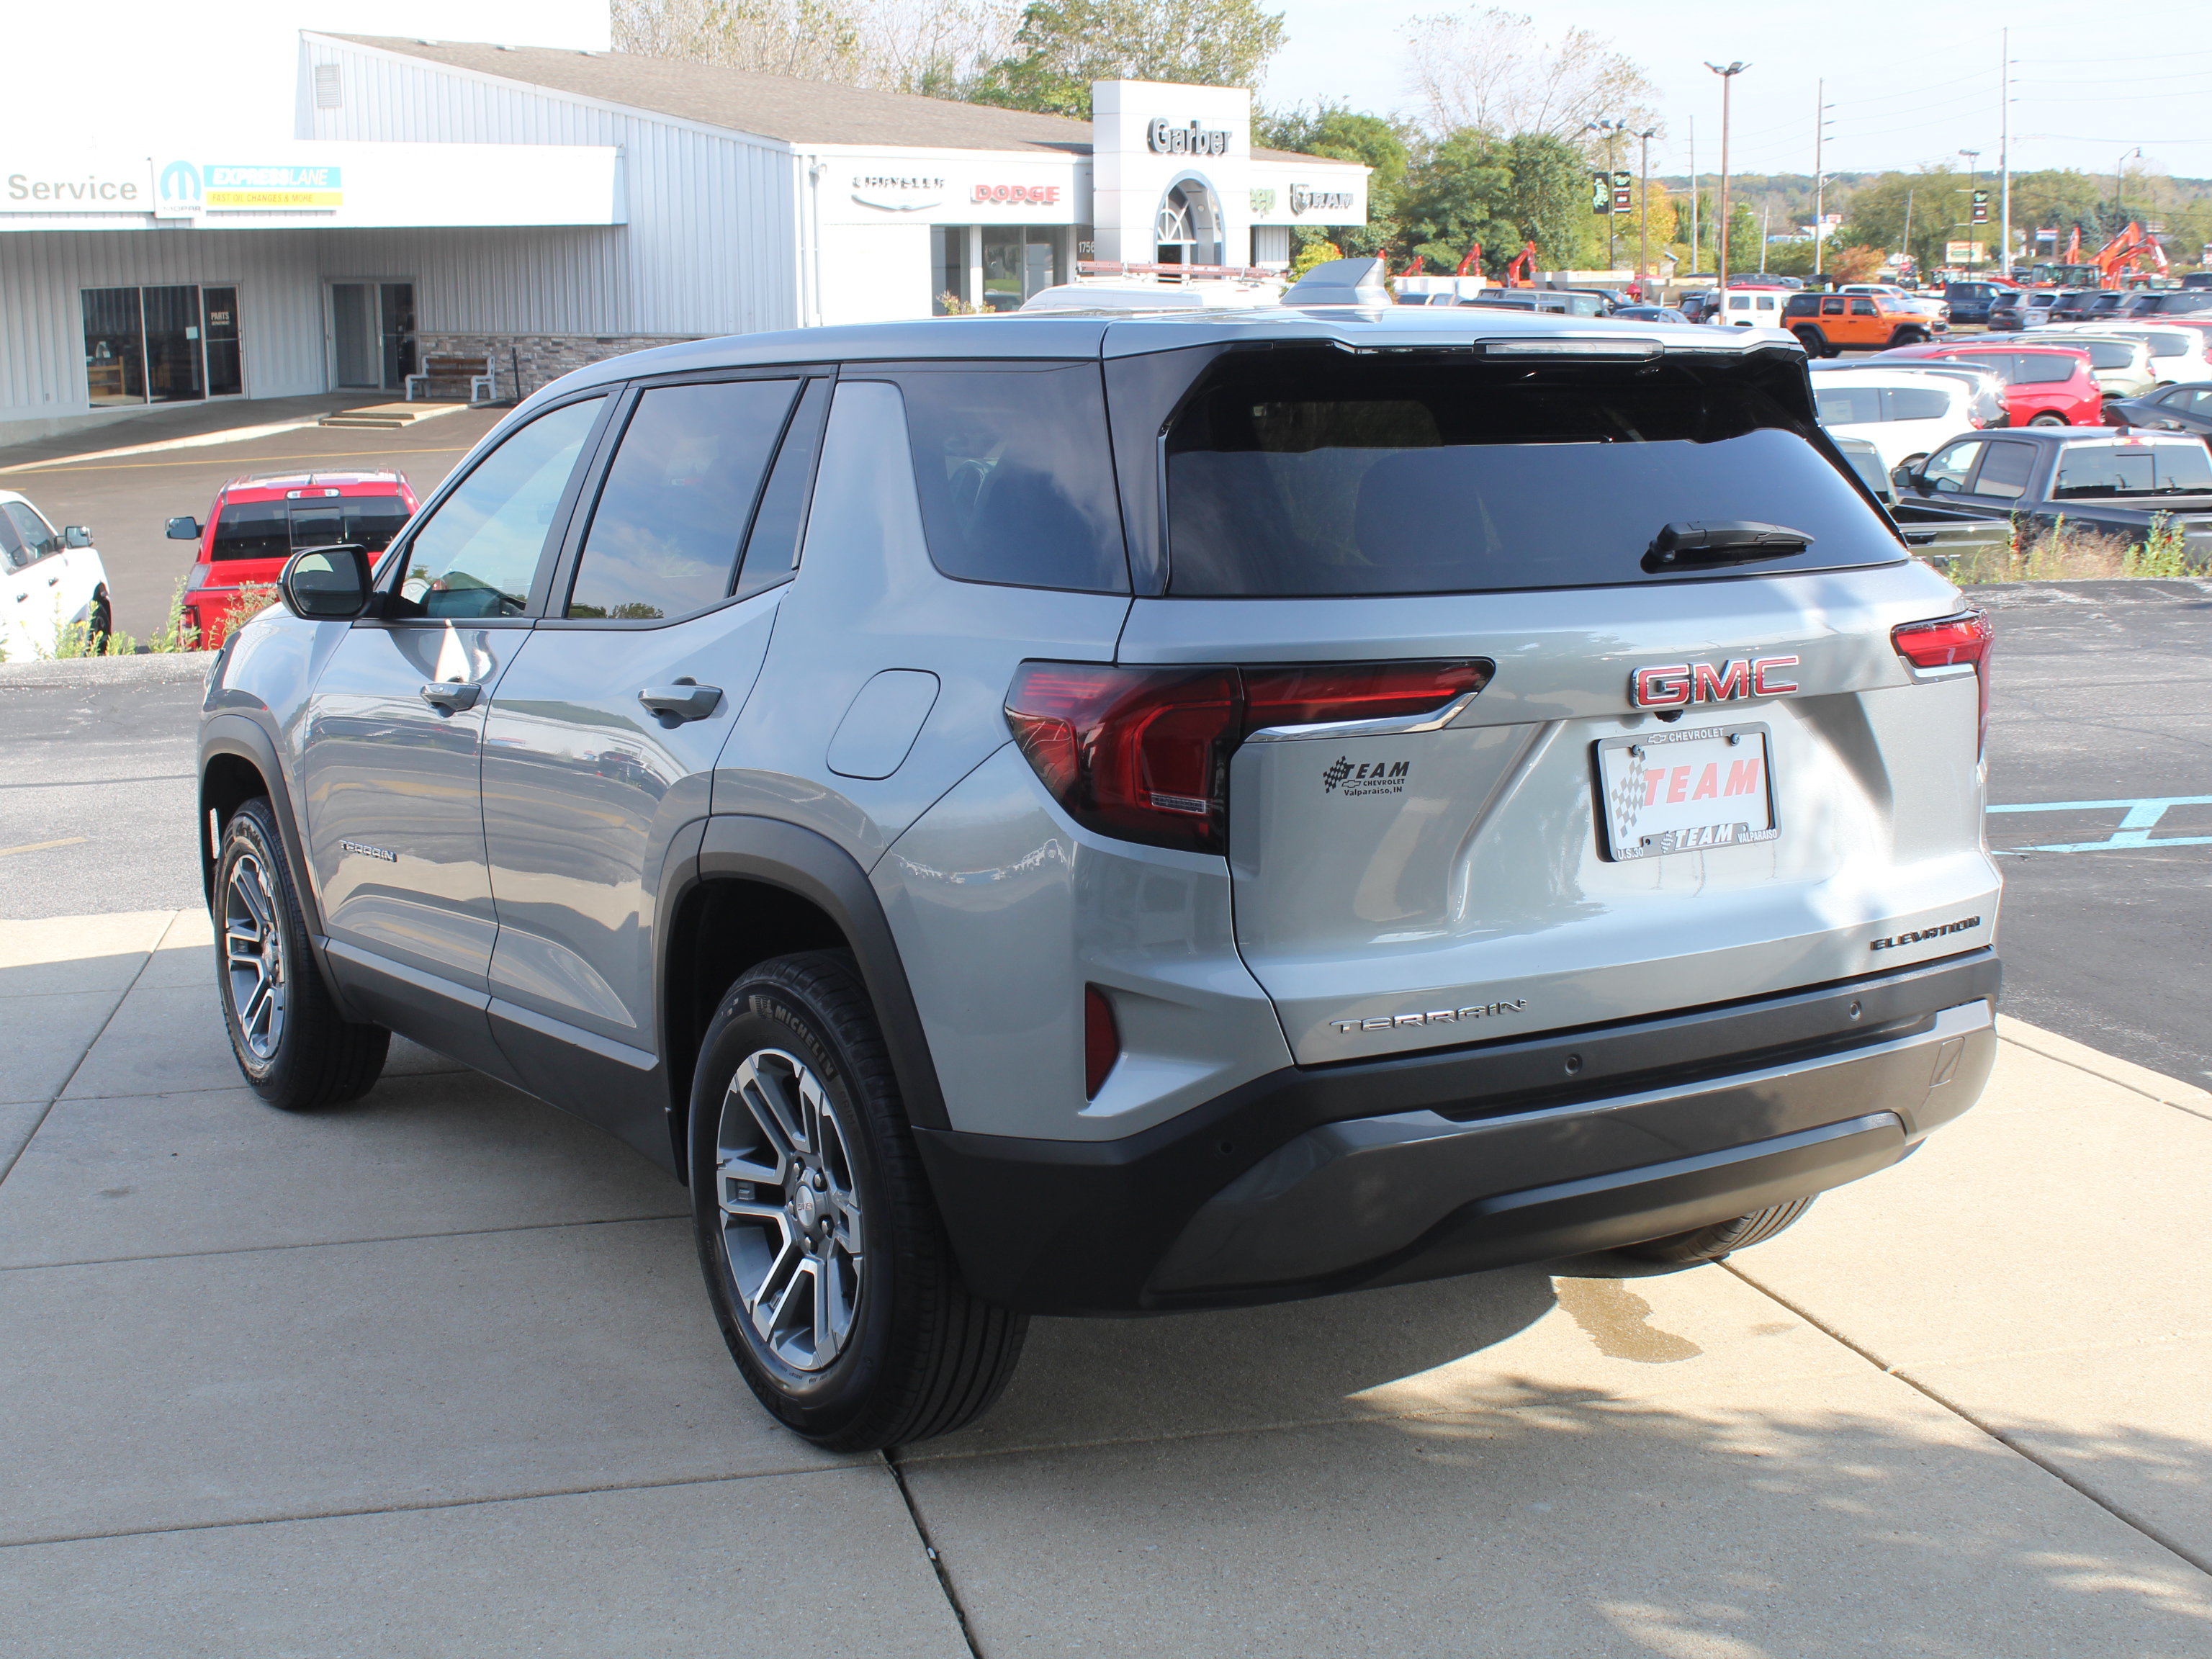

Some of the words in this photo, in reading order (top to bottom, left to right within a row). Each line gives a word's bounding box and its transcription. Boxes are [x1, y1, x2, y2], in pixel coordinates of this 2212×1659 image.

[1147, 117, 1233, 154] Garber
[7, 174, 138, 200] Service
[212, 194, 230, 202] FAST
[233, 194, 244, 202] OIL
[246, 194, 282, 202] CHANGES
[972, 184, 1060, 203] DODGE
[1310, 192, 1354, 209] RAM
[210, 312, 230, 321] PARTS
[1631, 655, 1799, 709] GMC
[1668, 728, 1725, 742] CHEVROLET
[1343, 761, 1410, 779] TEAM
[1344, 787, 1392, 796] Valparaiso,
[1642, 758, 1760, 806] TEAM
[1674, 824, 1733, 848] TEAM
[1737, 829, 1777, 844] VALPARAISO
[339, 840, 397, 863] TERRAIN
[1870, 915, 1980, 950] ELEVATION
[1330, 999, 1527, 1033] TERRAIN
[775, 1004, 835, 1077] MICHELIN
